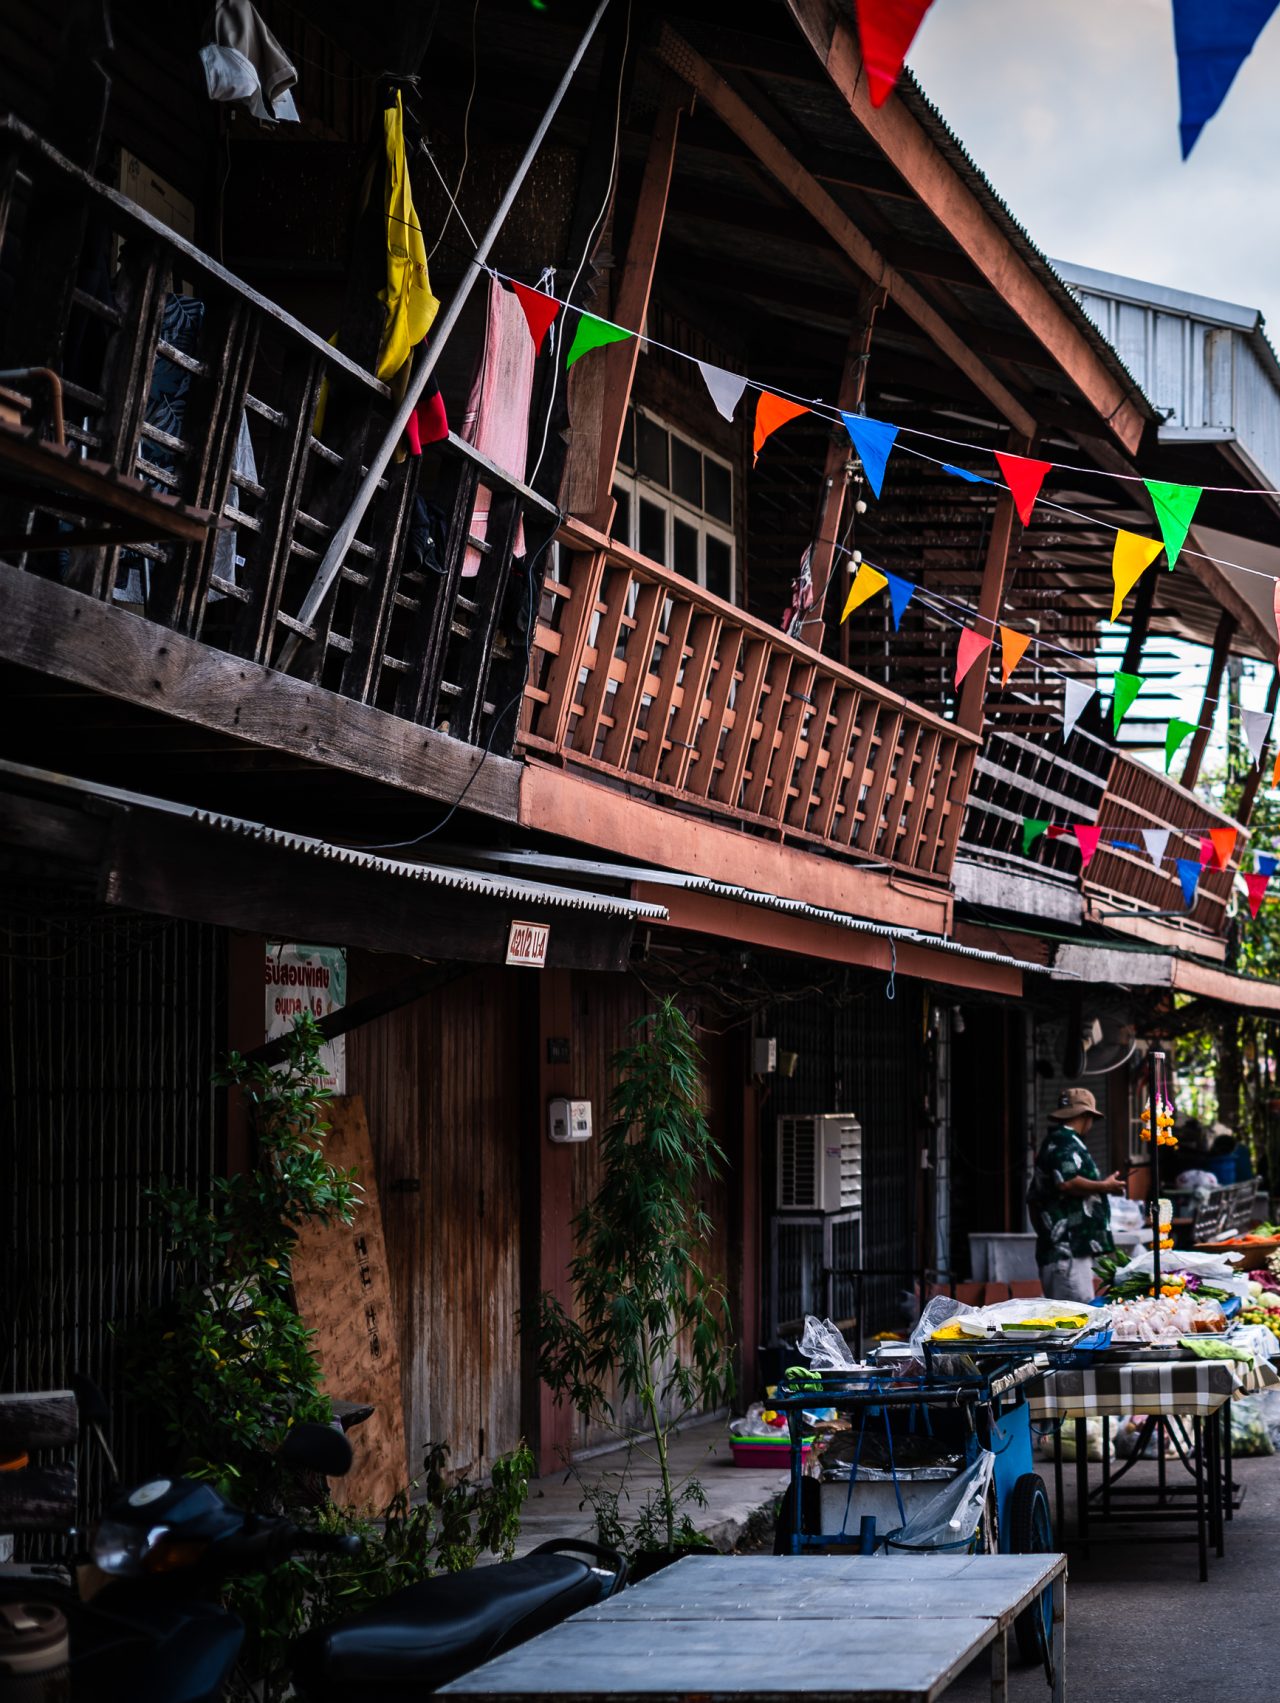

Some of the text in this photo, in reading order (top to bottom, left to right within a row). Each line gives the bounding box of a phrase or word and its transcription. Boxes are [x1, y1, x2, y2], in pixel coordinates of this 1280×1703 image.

[264, 956, 330, 988] รับสอนพิเศษ
[275, 997, 302, 1022] อนุบาล
